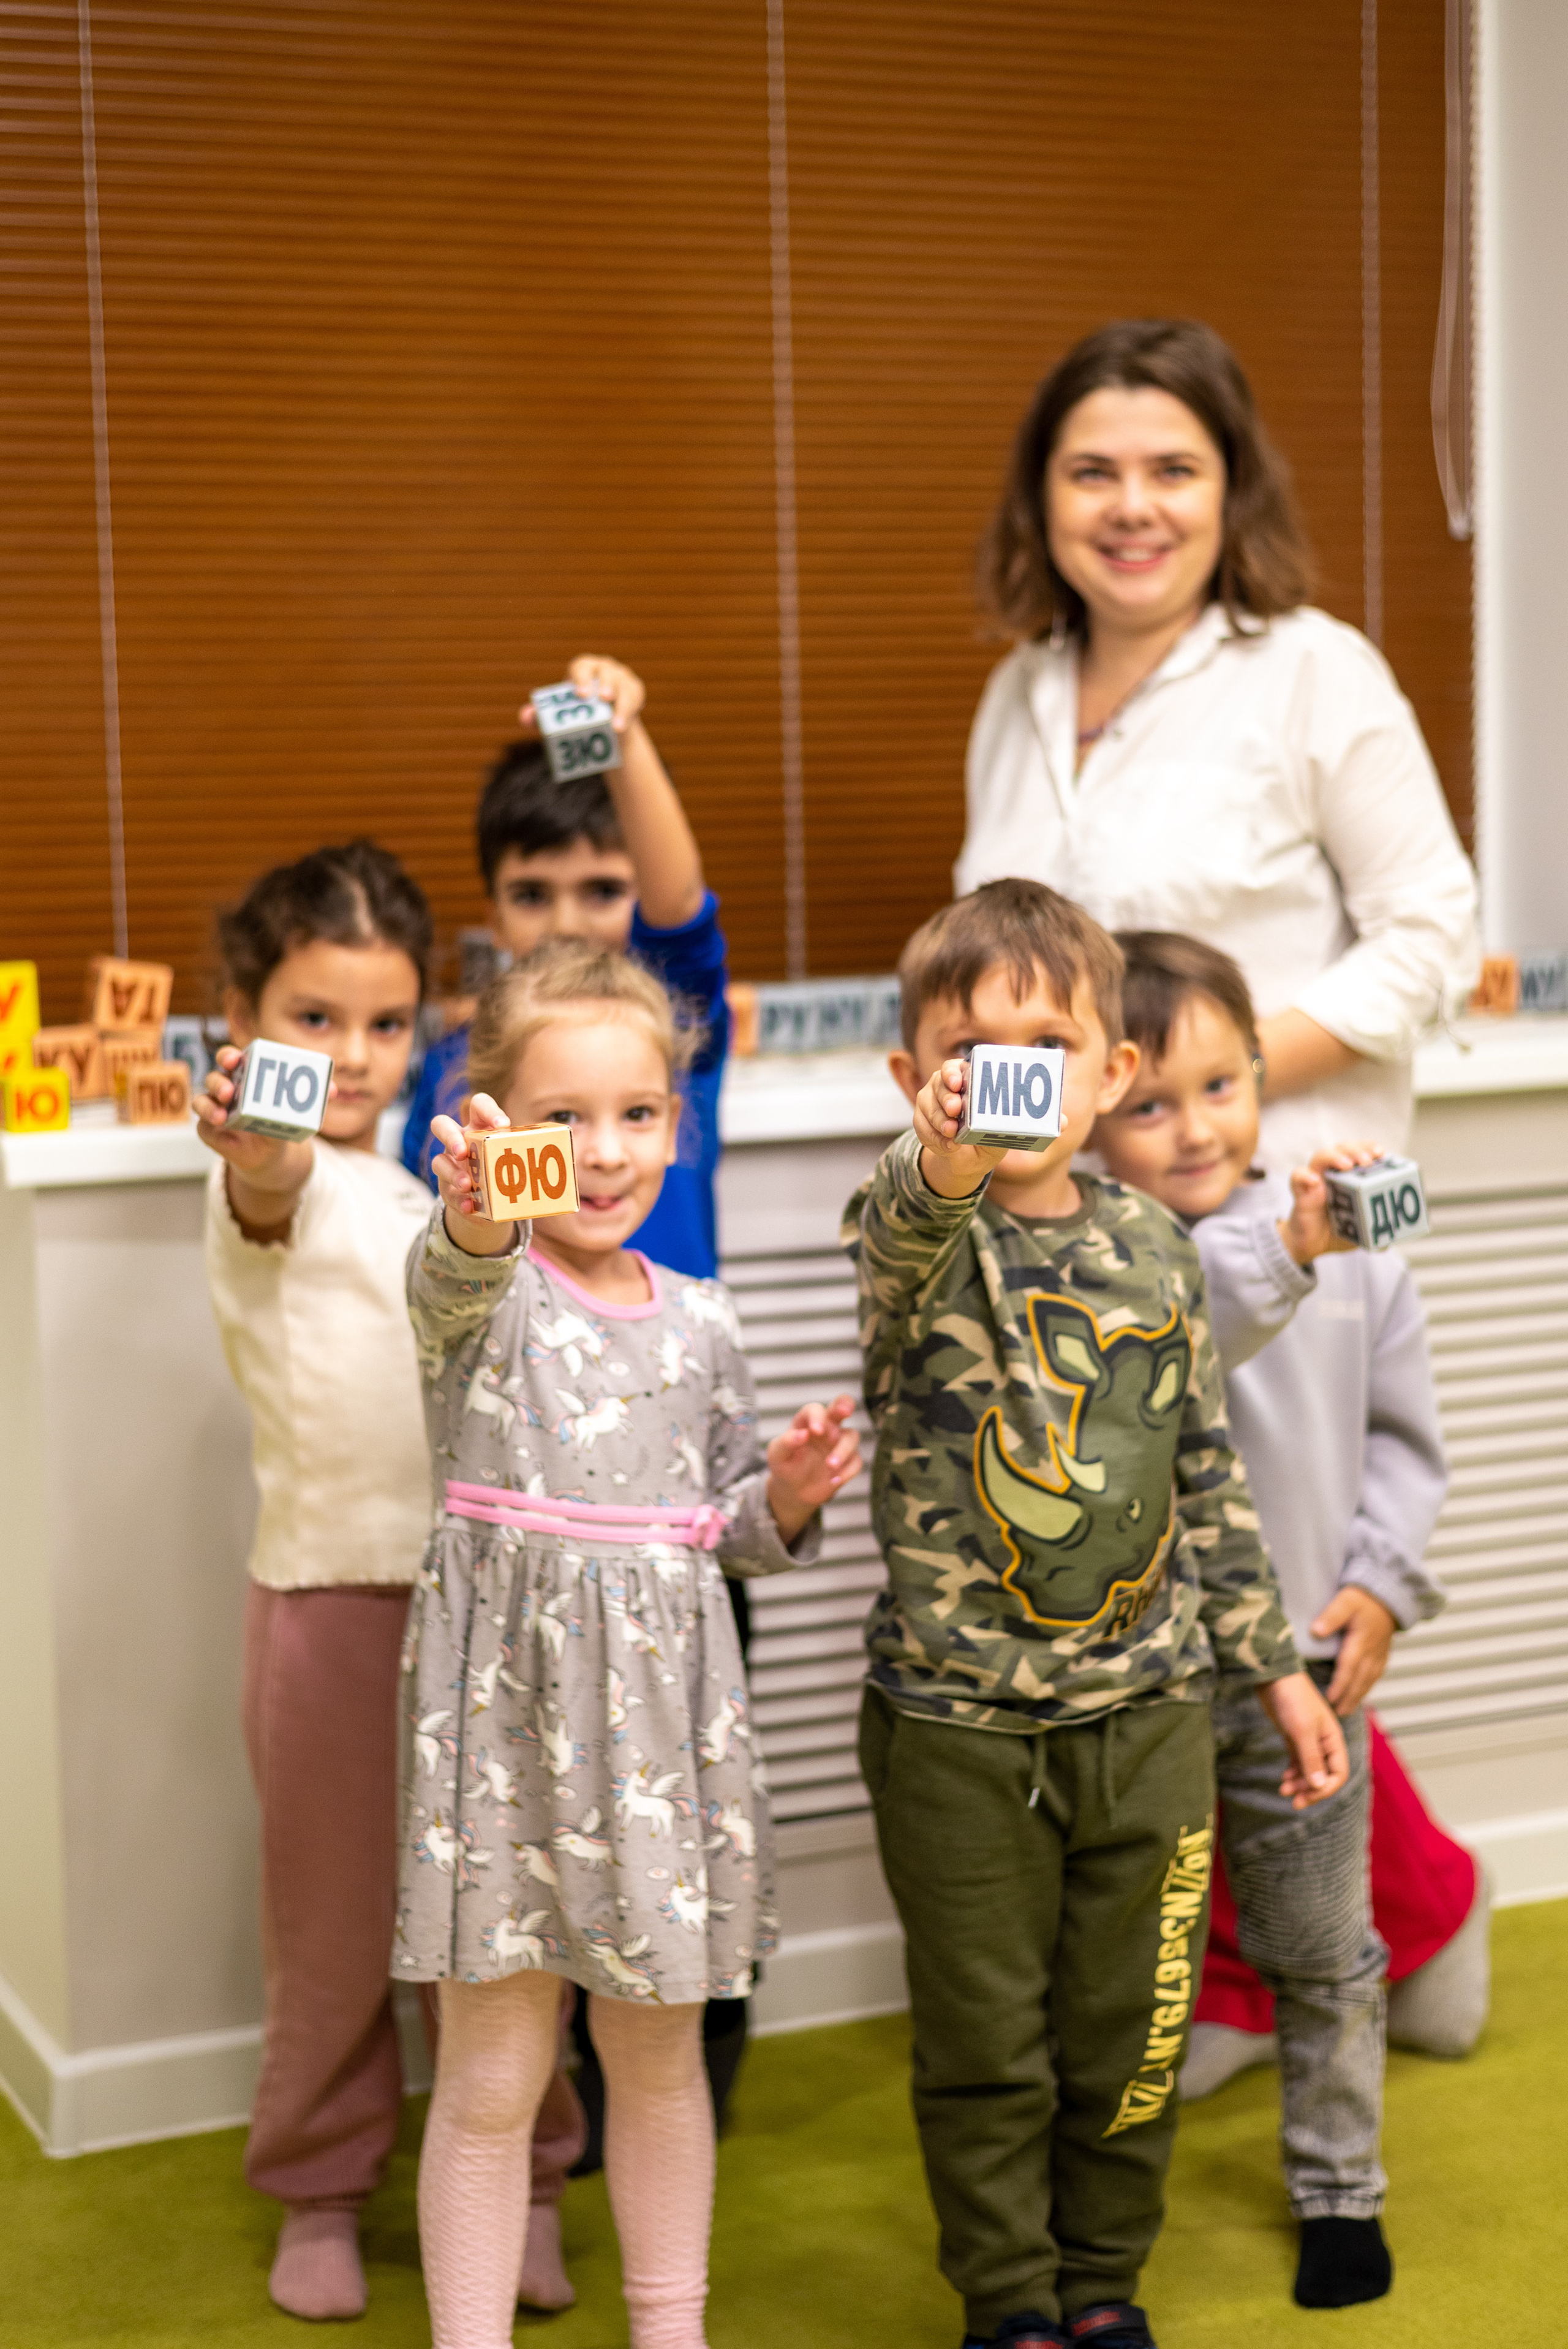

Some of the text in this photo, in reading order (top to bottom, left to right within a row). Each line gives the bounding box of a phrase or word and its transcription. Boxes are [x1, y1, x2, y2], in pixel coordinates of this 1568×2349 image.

[558, 733, 612, 771] ЗЮ
[15, 1086, 59, 1122] Ю
[252, 1057, 319, 1113] ГЮ
[978, 1061, 1052, 1119] МЮ
[494, 1144, 567, 1204] ФЮ
[1370, 1183, 1420, 1245] ДЮ
